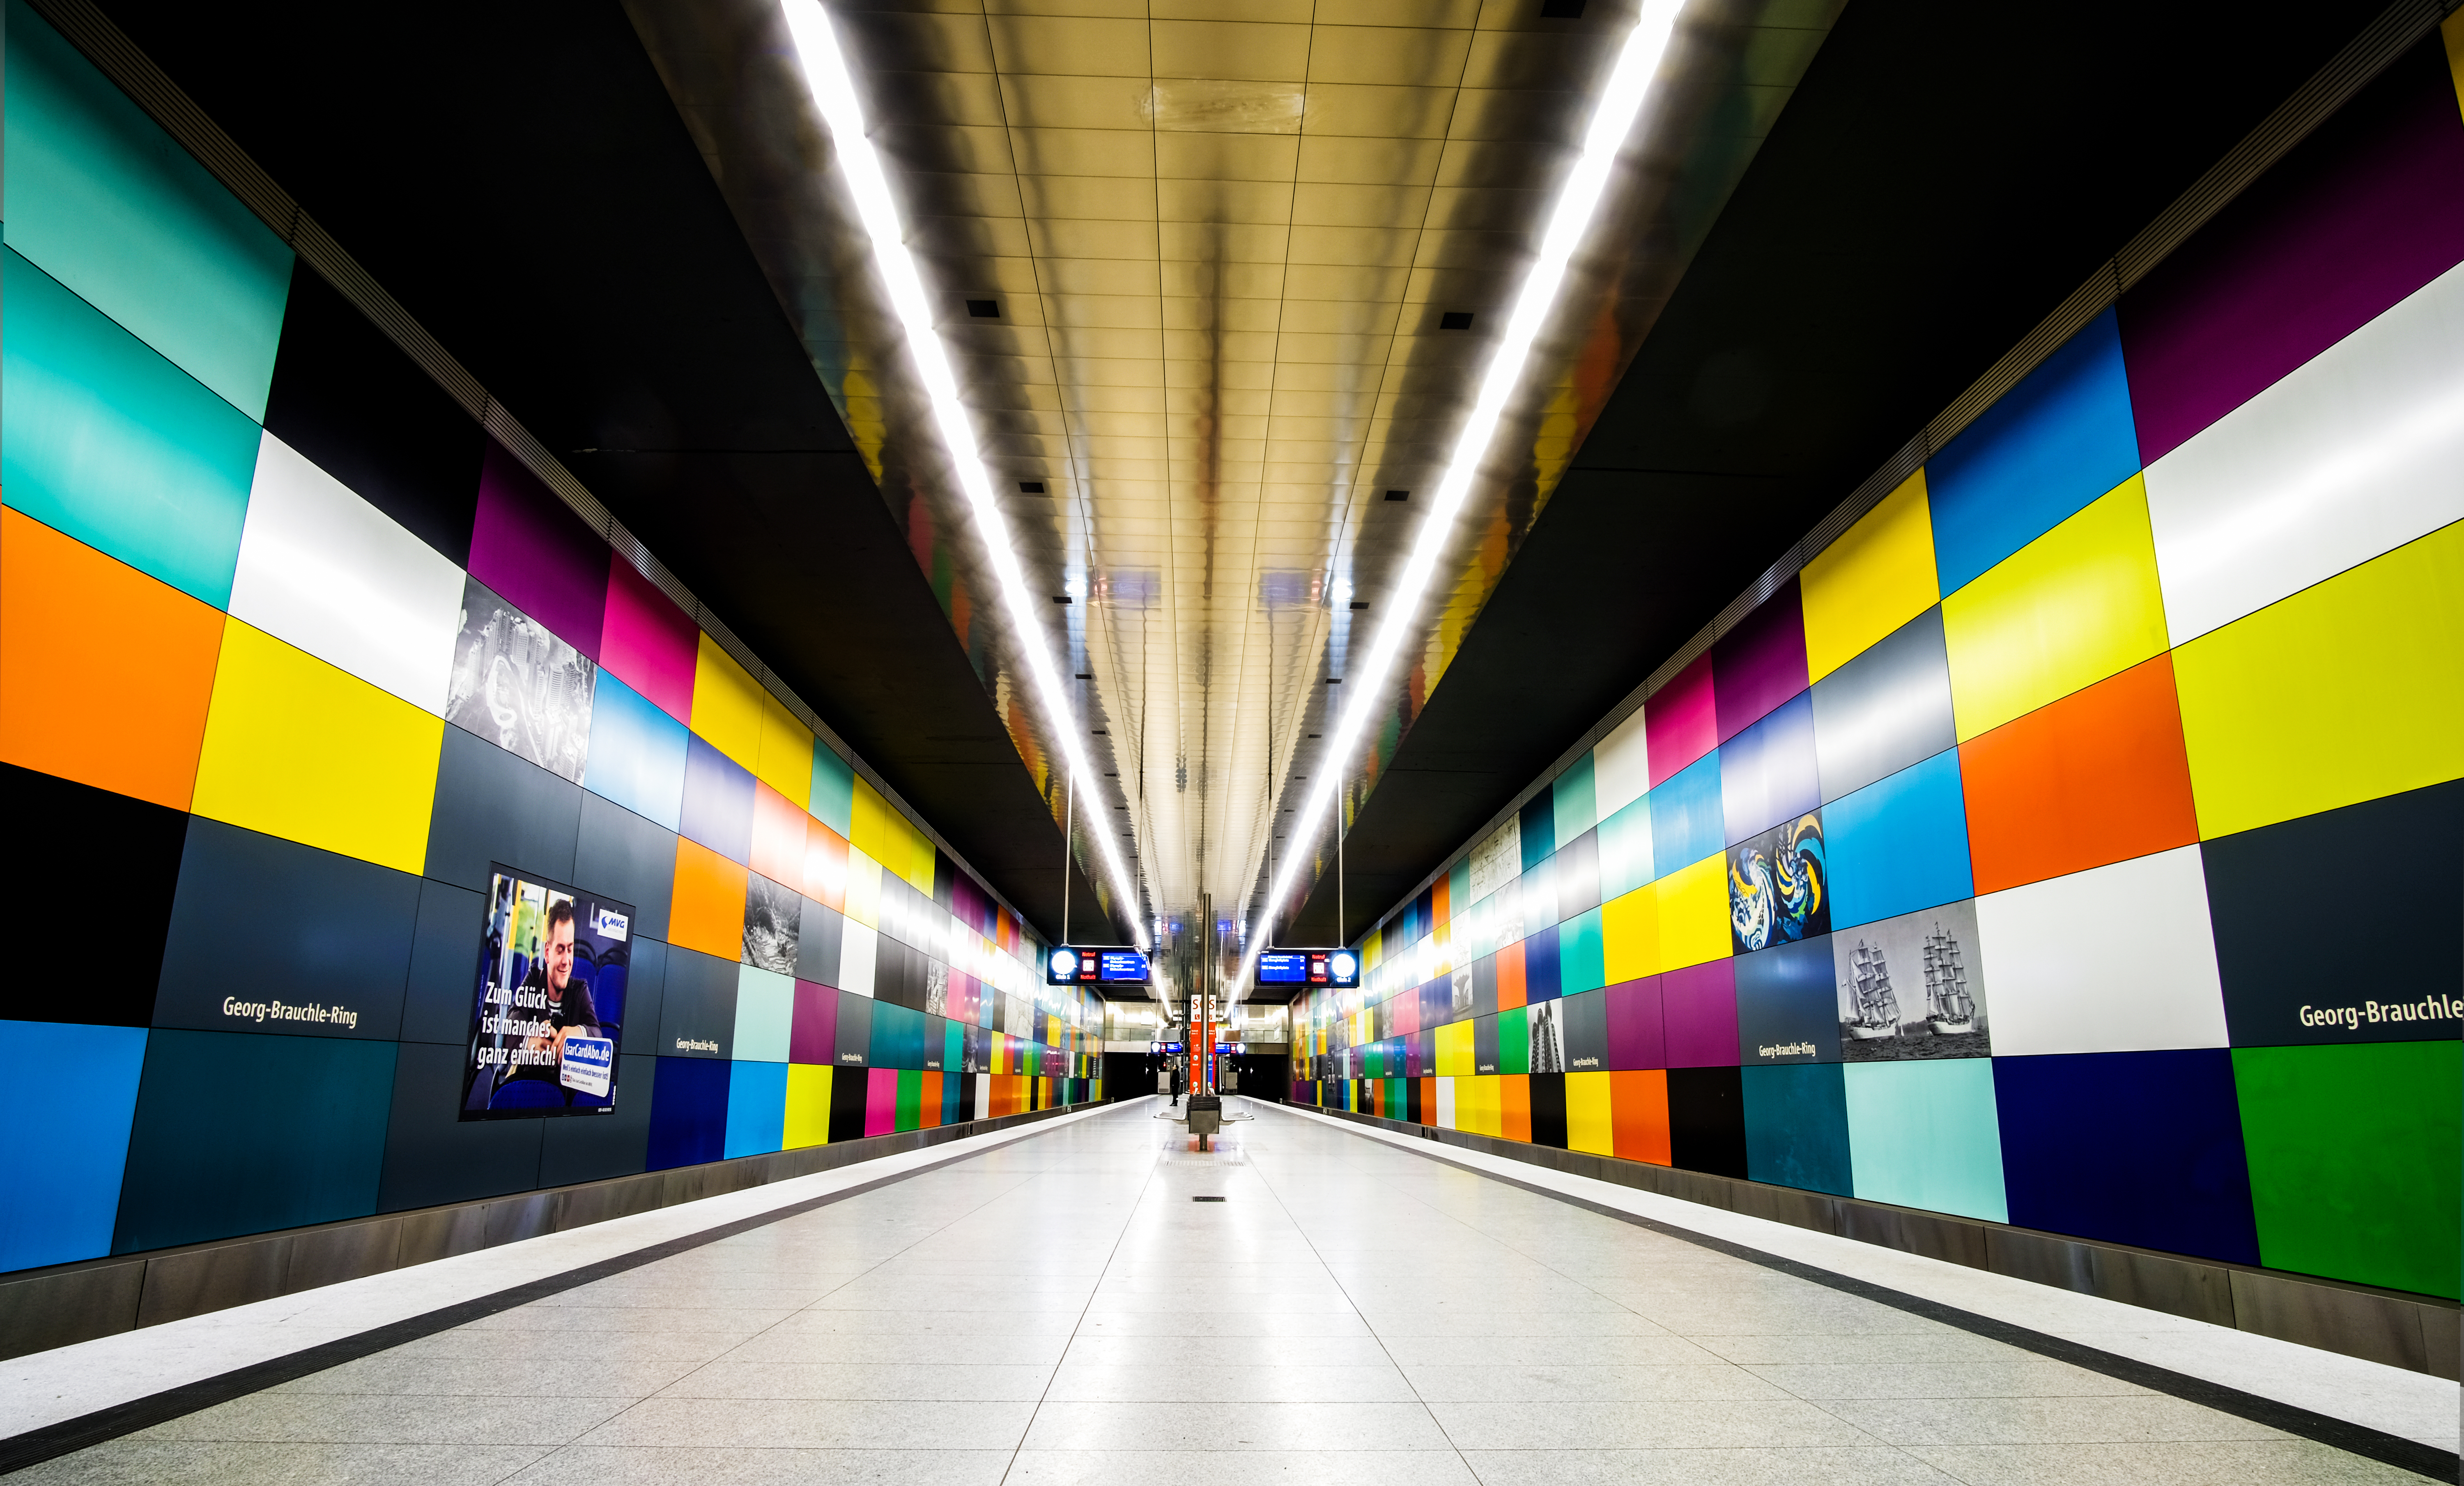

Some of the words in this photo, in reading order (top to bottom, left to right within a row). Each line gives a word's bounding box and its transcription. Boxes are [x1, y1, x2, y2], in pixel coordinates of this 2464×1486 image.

[609, 918, 625, 928] MVG
[485, 981, 512, 1005] Zum
[515, 986, 547, 1009] Glück
[223, 996, 357, 1029] Georg-Brauchle-Ring
[1193, 999, 1214, 1010] SS
[482, 1010, 499, 1034] ist
[501, 1016, 551, 1038] manches
[565, 1043, 609, 1061] IsarCardAbo.de
[676, 1038, 718, 1054] Georg-Brauchle-Ring
[1759, 1042, 1816, 1058] Georg-Brauchle-Ring
[477, 1047, 508, 1069] ganz
[510, 1043, 556, 1065] einfach!
[592, 1069, 602, 1078] besser
